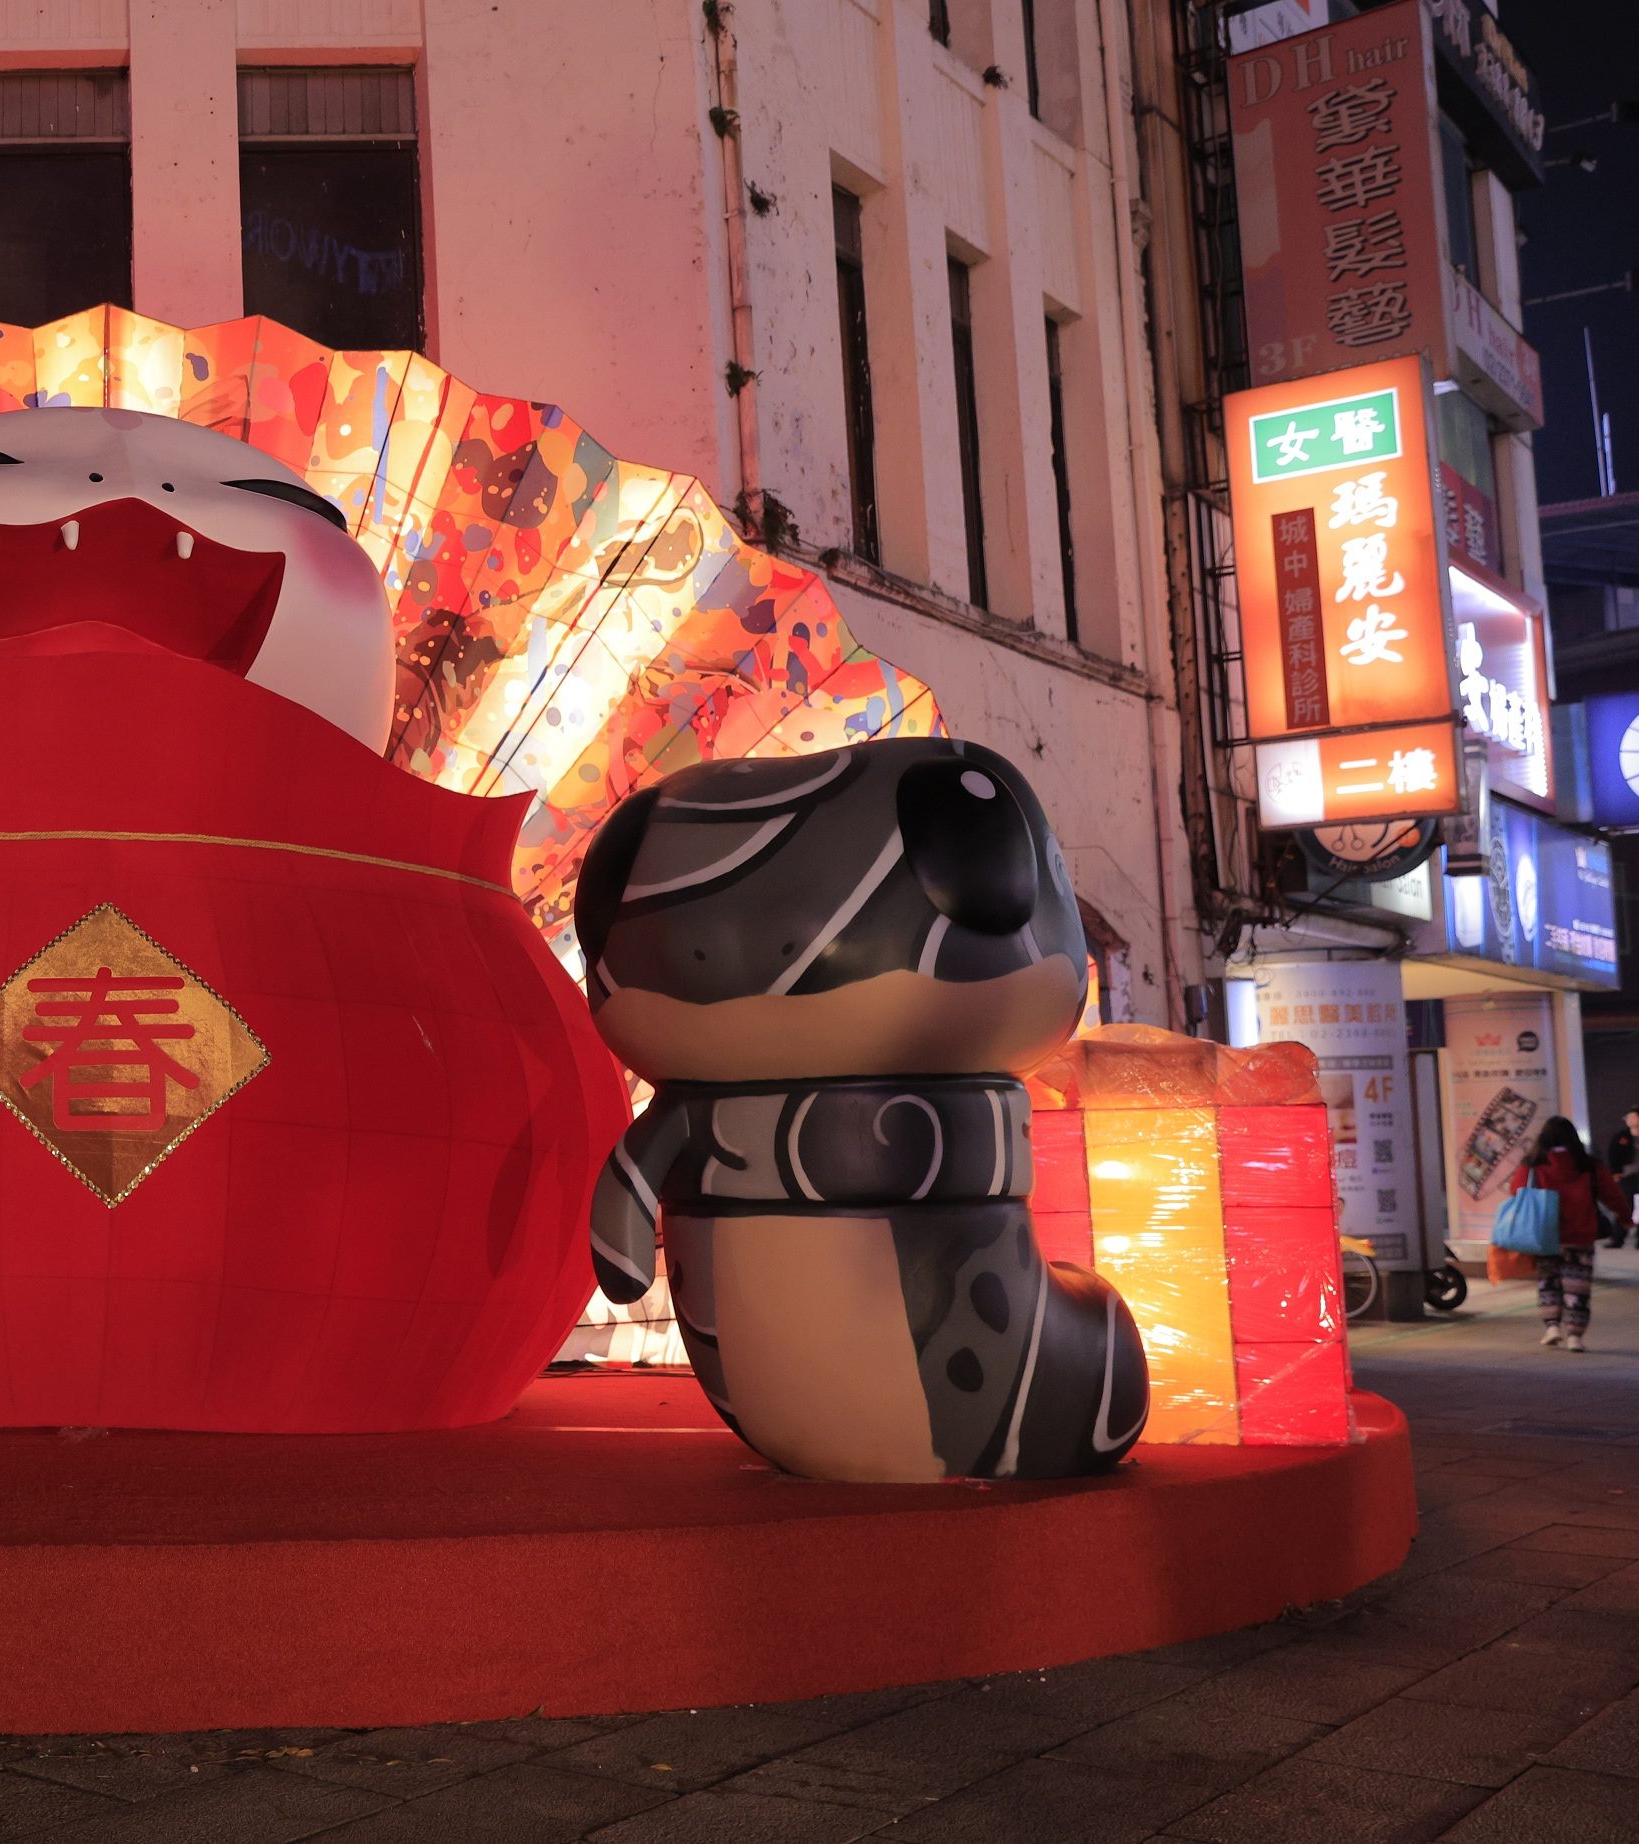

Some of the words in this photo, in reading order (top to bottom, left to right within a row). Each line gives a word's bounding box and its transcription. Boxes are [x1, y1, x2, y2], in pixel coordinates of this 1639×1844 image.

[1346, 35, 1409, 74] hair
[1260, 334, 1316, 375] 3F
[1266, 407, 1385, 467] 女醫
[1328, 471, 1409, 665] 瑪麗安
[1336, 747, 1438, 795] 二樓
[1328, 856, 1359, 873] Hair
[19, 966, 200, 1131] 春
[1365, 1075, 1395, 1103] 4F
